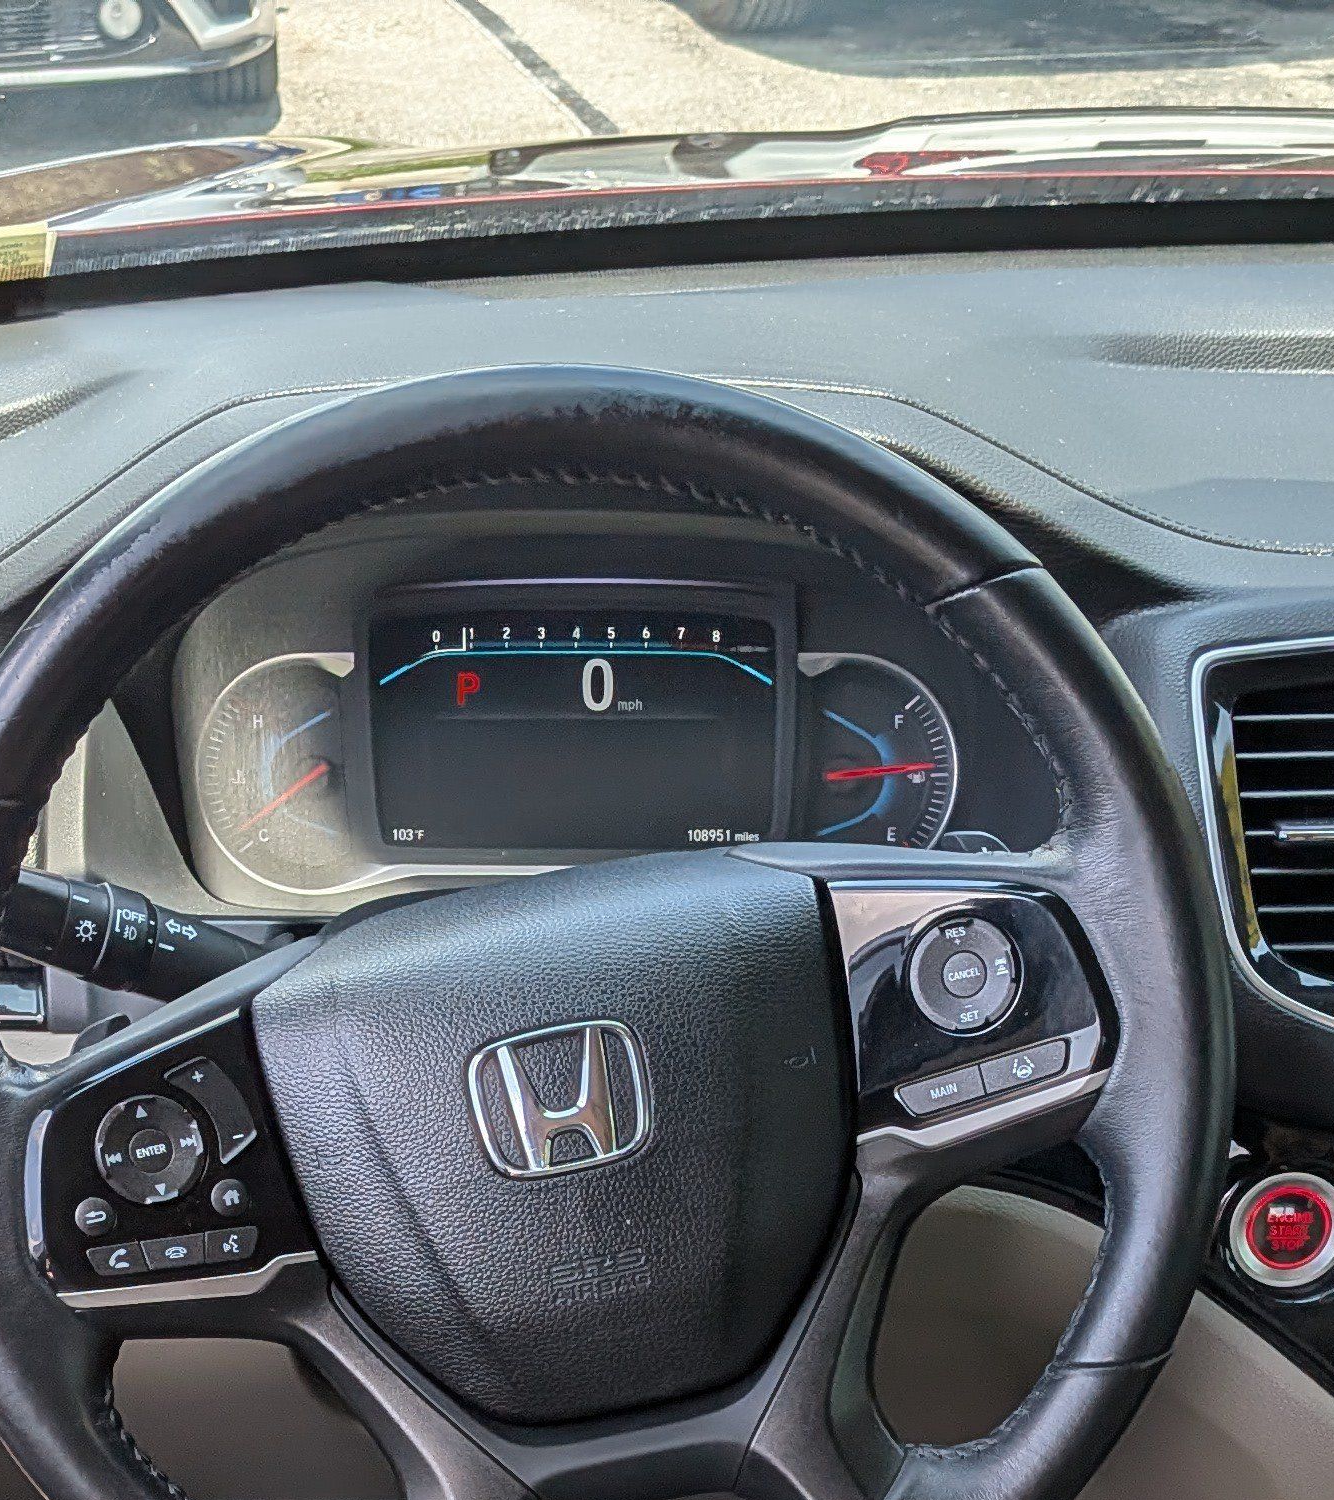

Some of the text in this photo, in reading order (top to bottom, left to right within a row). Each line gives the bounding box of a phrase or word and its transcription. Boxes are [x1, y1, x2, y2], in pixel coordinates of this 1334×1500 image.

[432, 630, 441, 643] 0
[468, 628, 474, 640] 1
[502, 627, 510, 640] 2
[537, 627, 546, 640] 3
[572, 627, 580, 640] 4
[607, 627, 616, 640] 5
[642, 627, 650, 640] 6
[677, 627, 685, 640] 7
[712, 630, 721, 643] 8
[456, 671, 480, 706] P
[581, 658, 643, 712] 0 mph
[252, 714, 263, 729] H
[894, 714, 904, 729] F
[259, 829, 269, 842] C
[687, 829, 760, 842] 108951 miles
[887, 827, 897, 842] E
[122, 909, 147, 925] OFF
[945, 926, 966, 940] RES
[948, 967, 981, 982] CANCEL
[960, 1010, 979, 1024] SET
[929, 1082, 958, 1100] MAIN
[135, 1143, 167, 1159] ENTER
